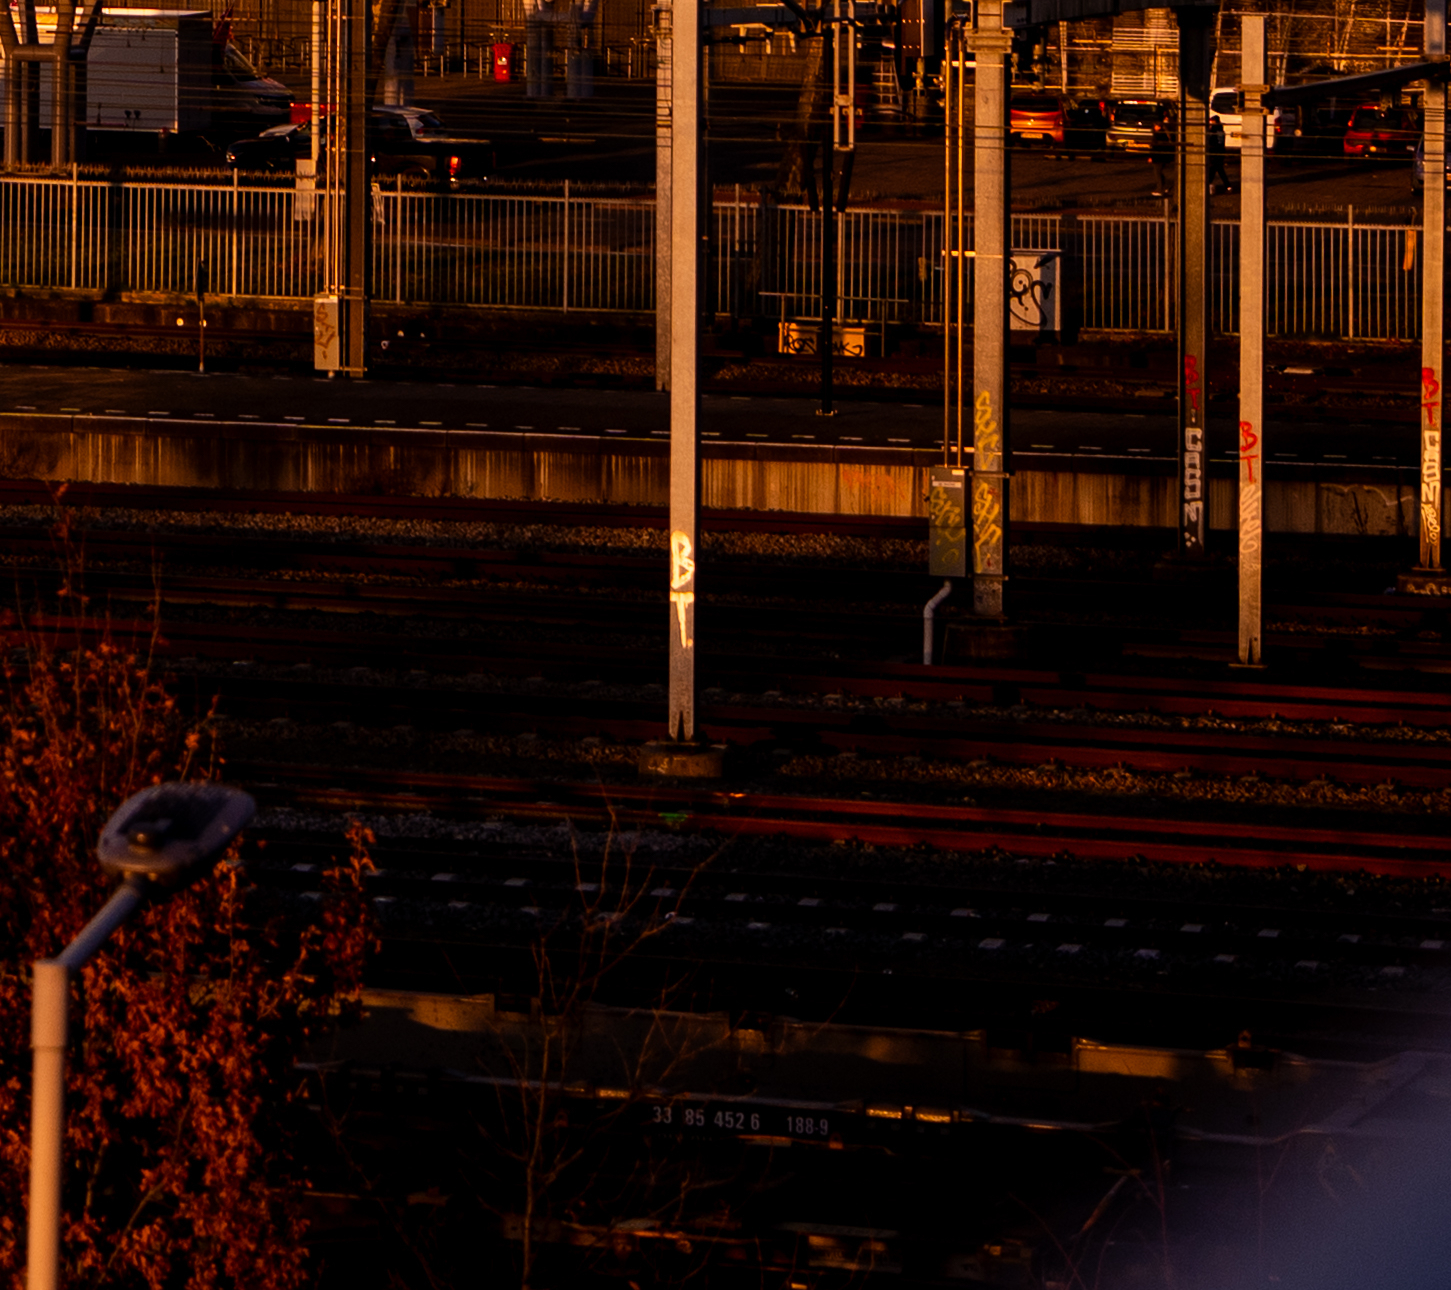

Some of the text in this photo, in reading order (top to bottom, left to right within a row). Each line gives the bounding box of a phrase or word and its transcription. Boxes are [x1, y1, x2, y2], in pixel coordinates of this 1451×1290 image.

[1239, 420, 1259, 484] BT
[670, 530, 695, 649] BT
[652, 1105, 673, 1125] 33
[684, 1107, 705, 1128] 85
[786, 1115, 830, 1137] 188-9
